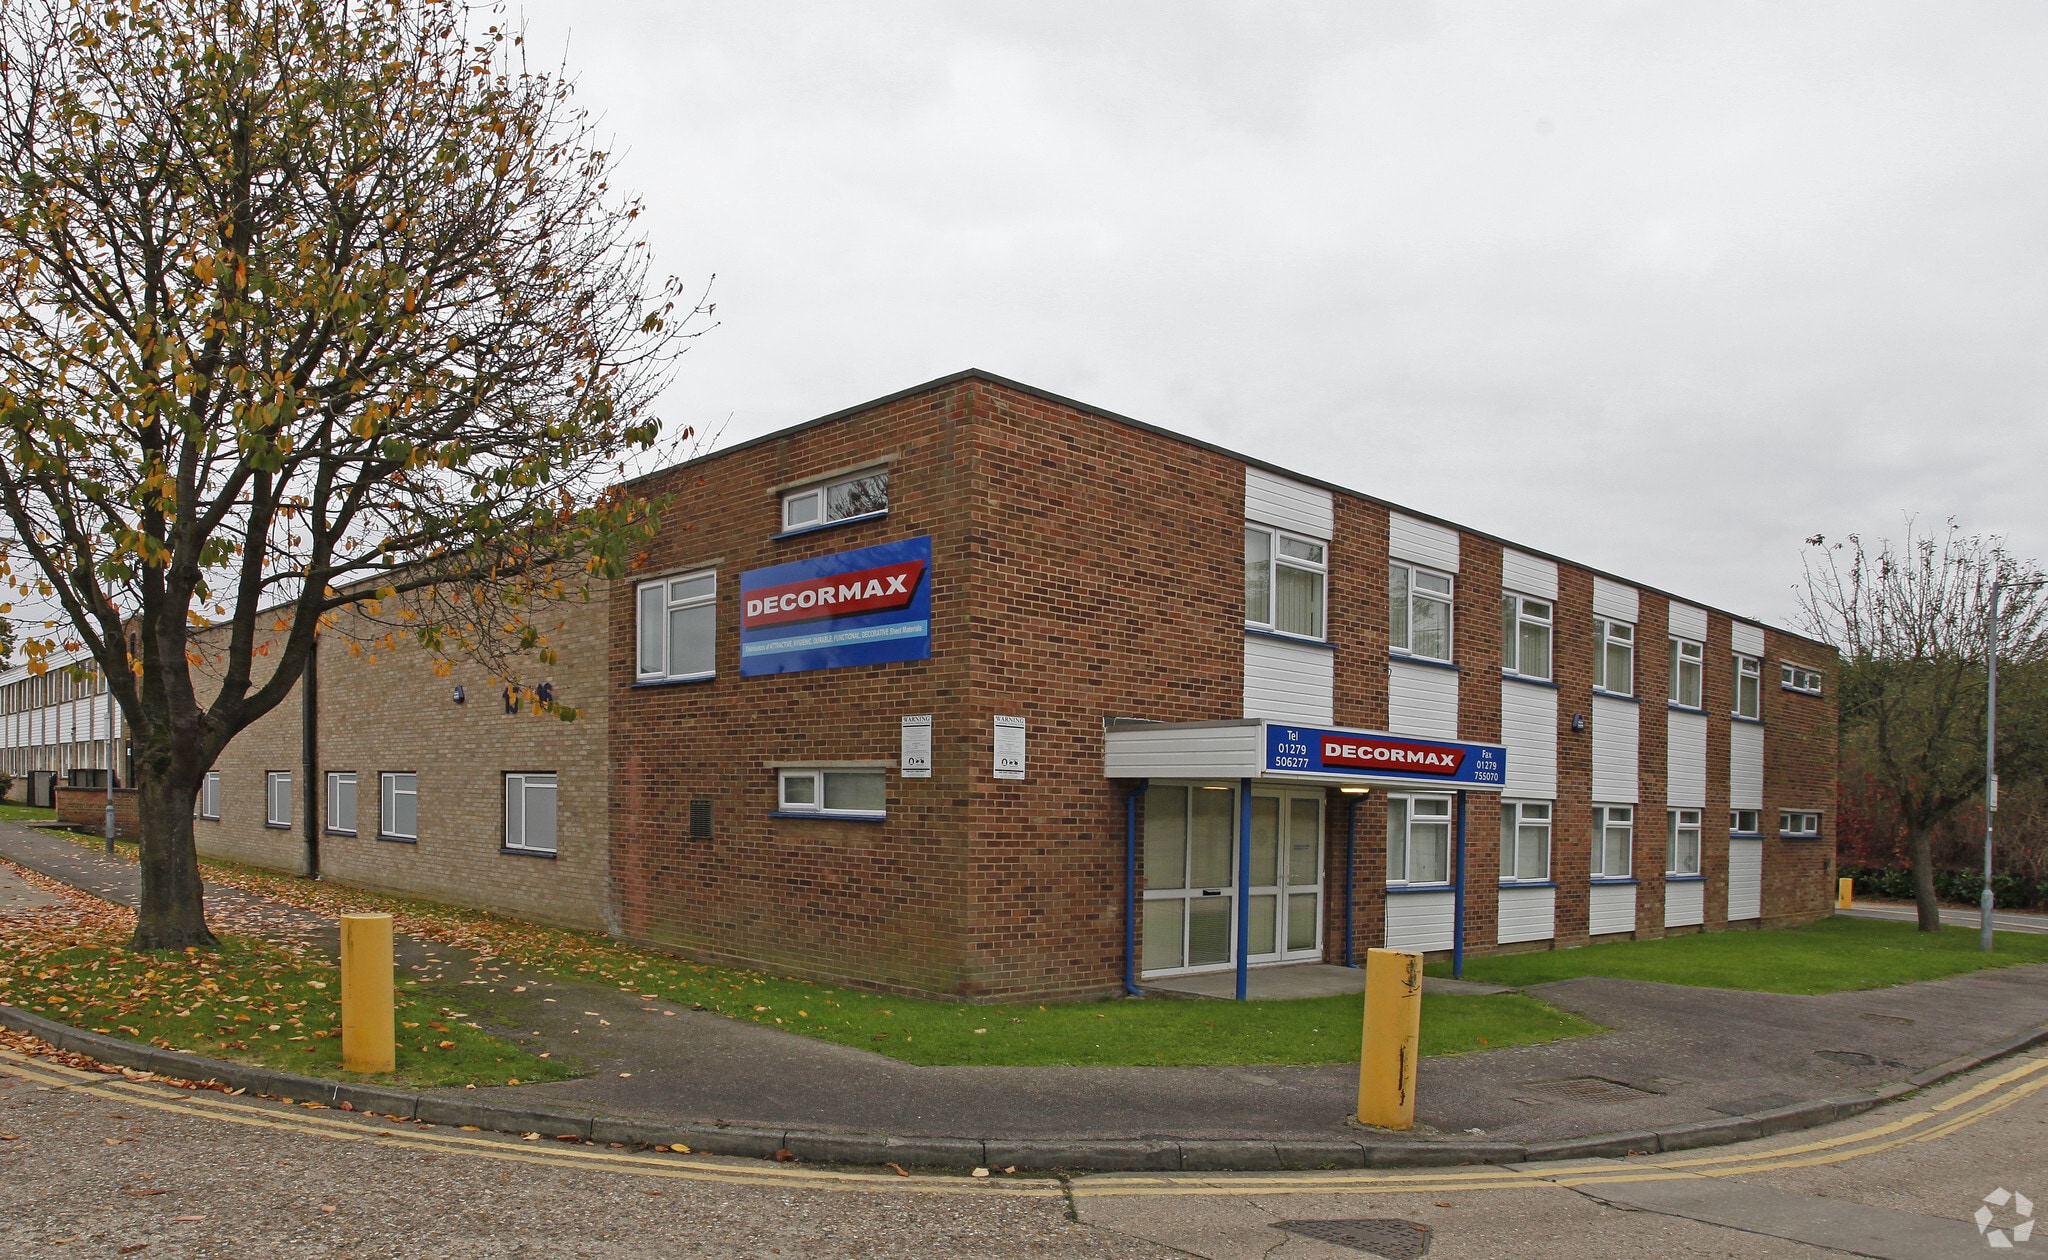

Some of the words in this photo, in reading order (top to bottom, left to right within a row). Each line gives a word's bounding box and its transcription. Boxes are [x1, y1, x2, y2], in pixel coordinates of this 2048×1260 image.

[747, 573, 908, 617] DECORMAX
[862, 628, 889, 638] DECORATIVE
[890, 627, 902, 635] Sheet
[902, 624, 922, 633] Materials
[1287, 730, 1299, 741] Tel
[1278, 743, 1307, 755] 01279
[1325, 743, 1454, 767] DECORMAX
[1482, 749, 1493, 759] Fax
[1275, 756, 1309, 768] 506277
[1476, 760, 1497, 771] 01279
[1474, 771, 1499, 782] 755070
